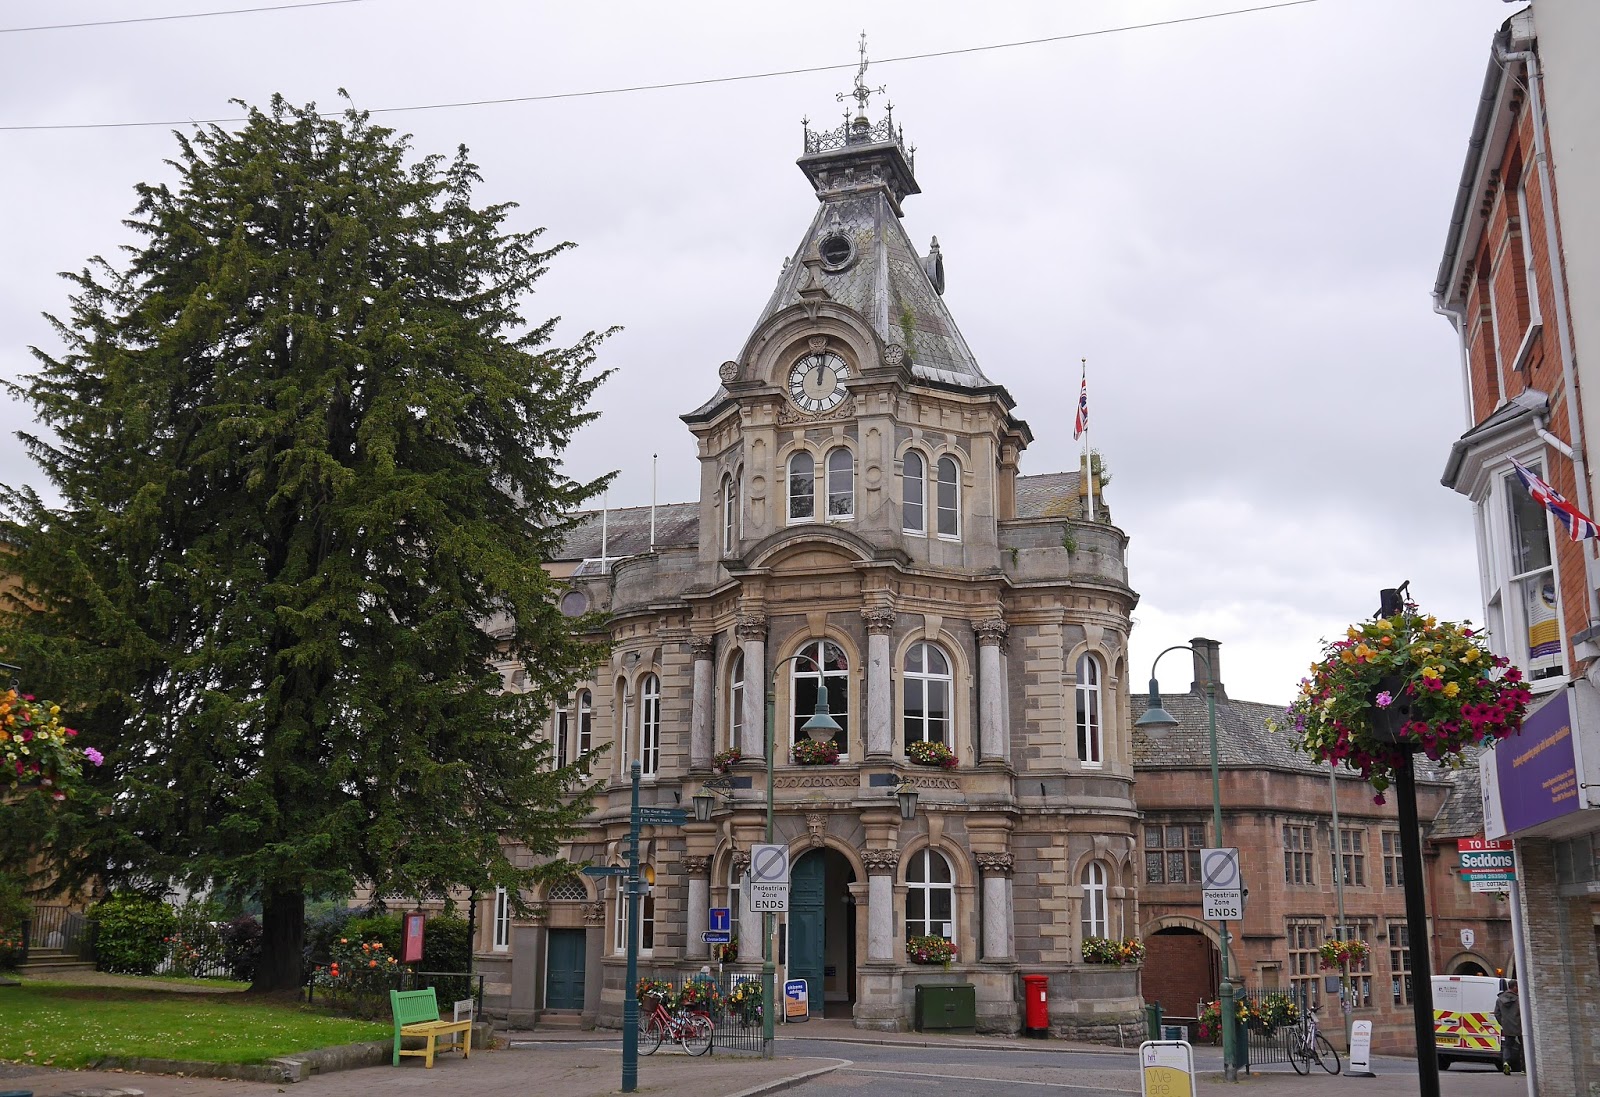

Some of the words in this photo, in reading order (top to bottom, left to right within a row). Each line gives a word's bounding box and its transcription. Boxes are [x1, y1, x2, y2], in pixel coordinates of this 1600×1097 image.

[1468, 840, 1482, 849] TO
[1484, 840, 1501, 849] LET
[1461, 853, 1513, 868] Seddons
[755, 900, 784, 909] ENDS
[1208, 907, 1238, 917] ENDS
[1148, 1070, 1172, 1083] We
[1150, 1084, 1170, 1095] are
